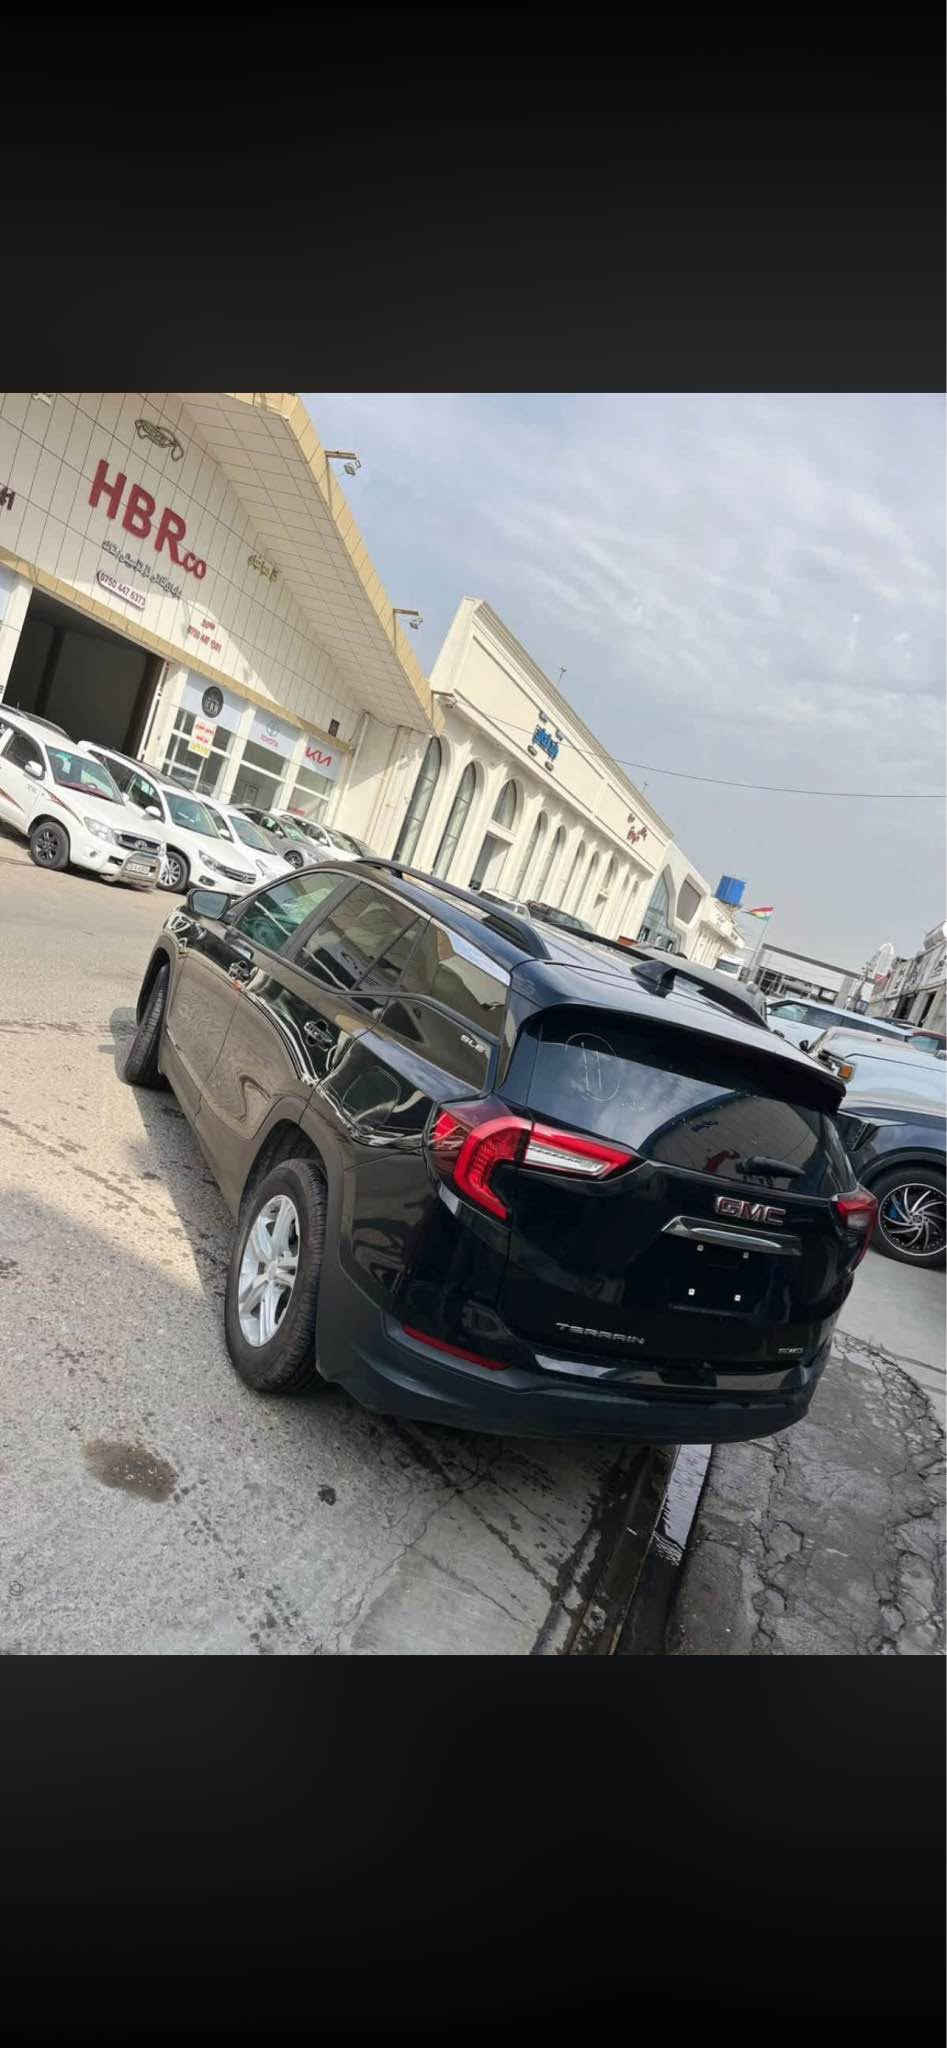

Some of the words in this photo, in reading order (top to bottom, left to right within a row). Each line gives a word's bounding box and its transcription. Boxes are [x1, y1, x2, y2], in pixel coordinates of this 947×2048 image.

[100, 572, 117, 588] 0750
[716, 1196, 786, 1226] GMC
[556, 1321, 646, 1345] TERRAIN
